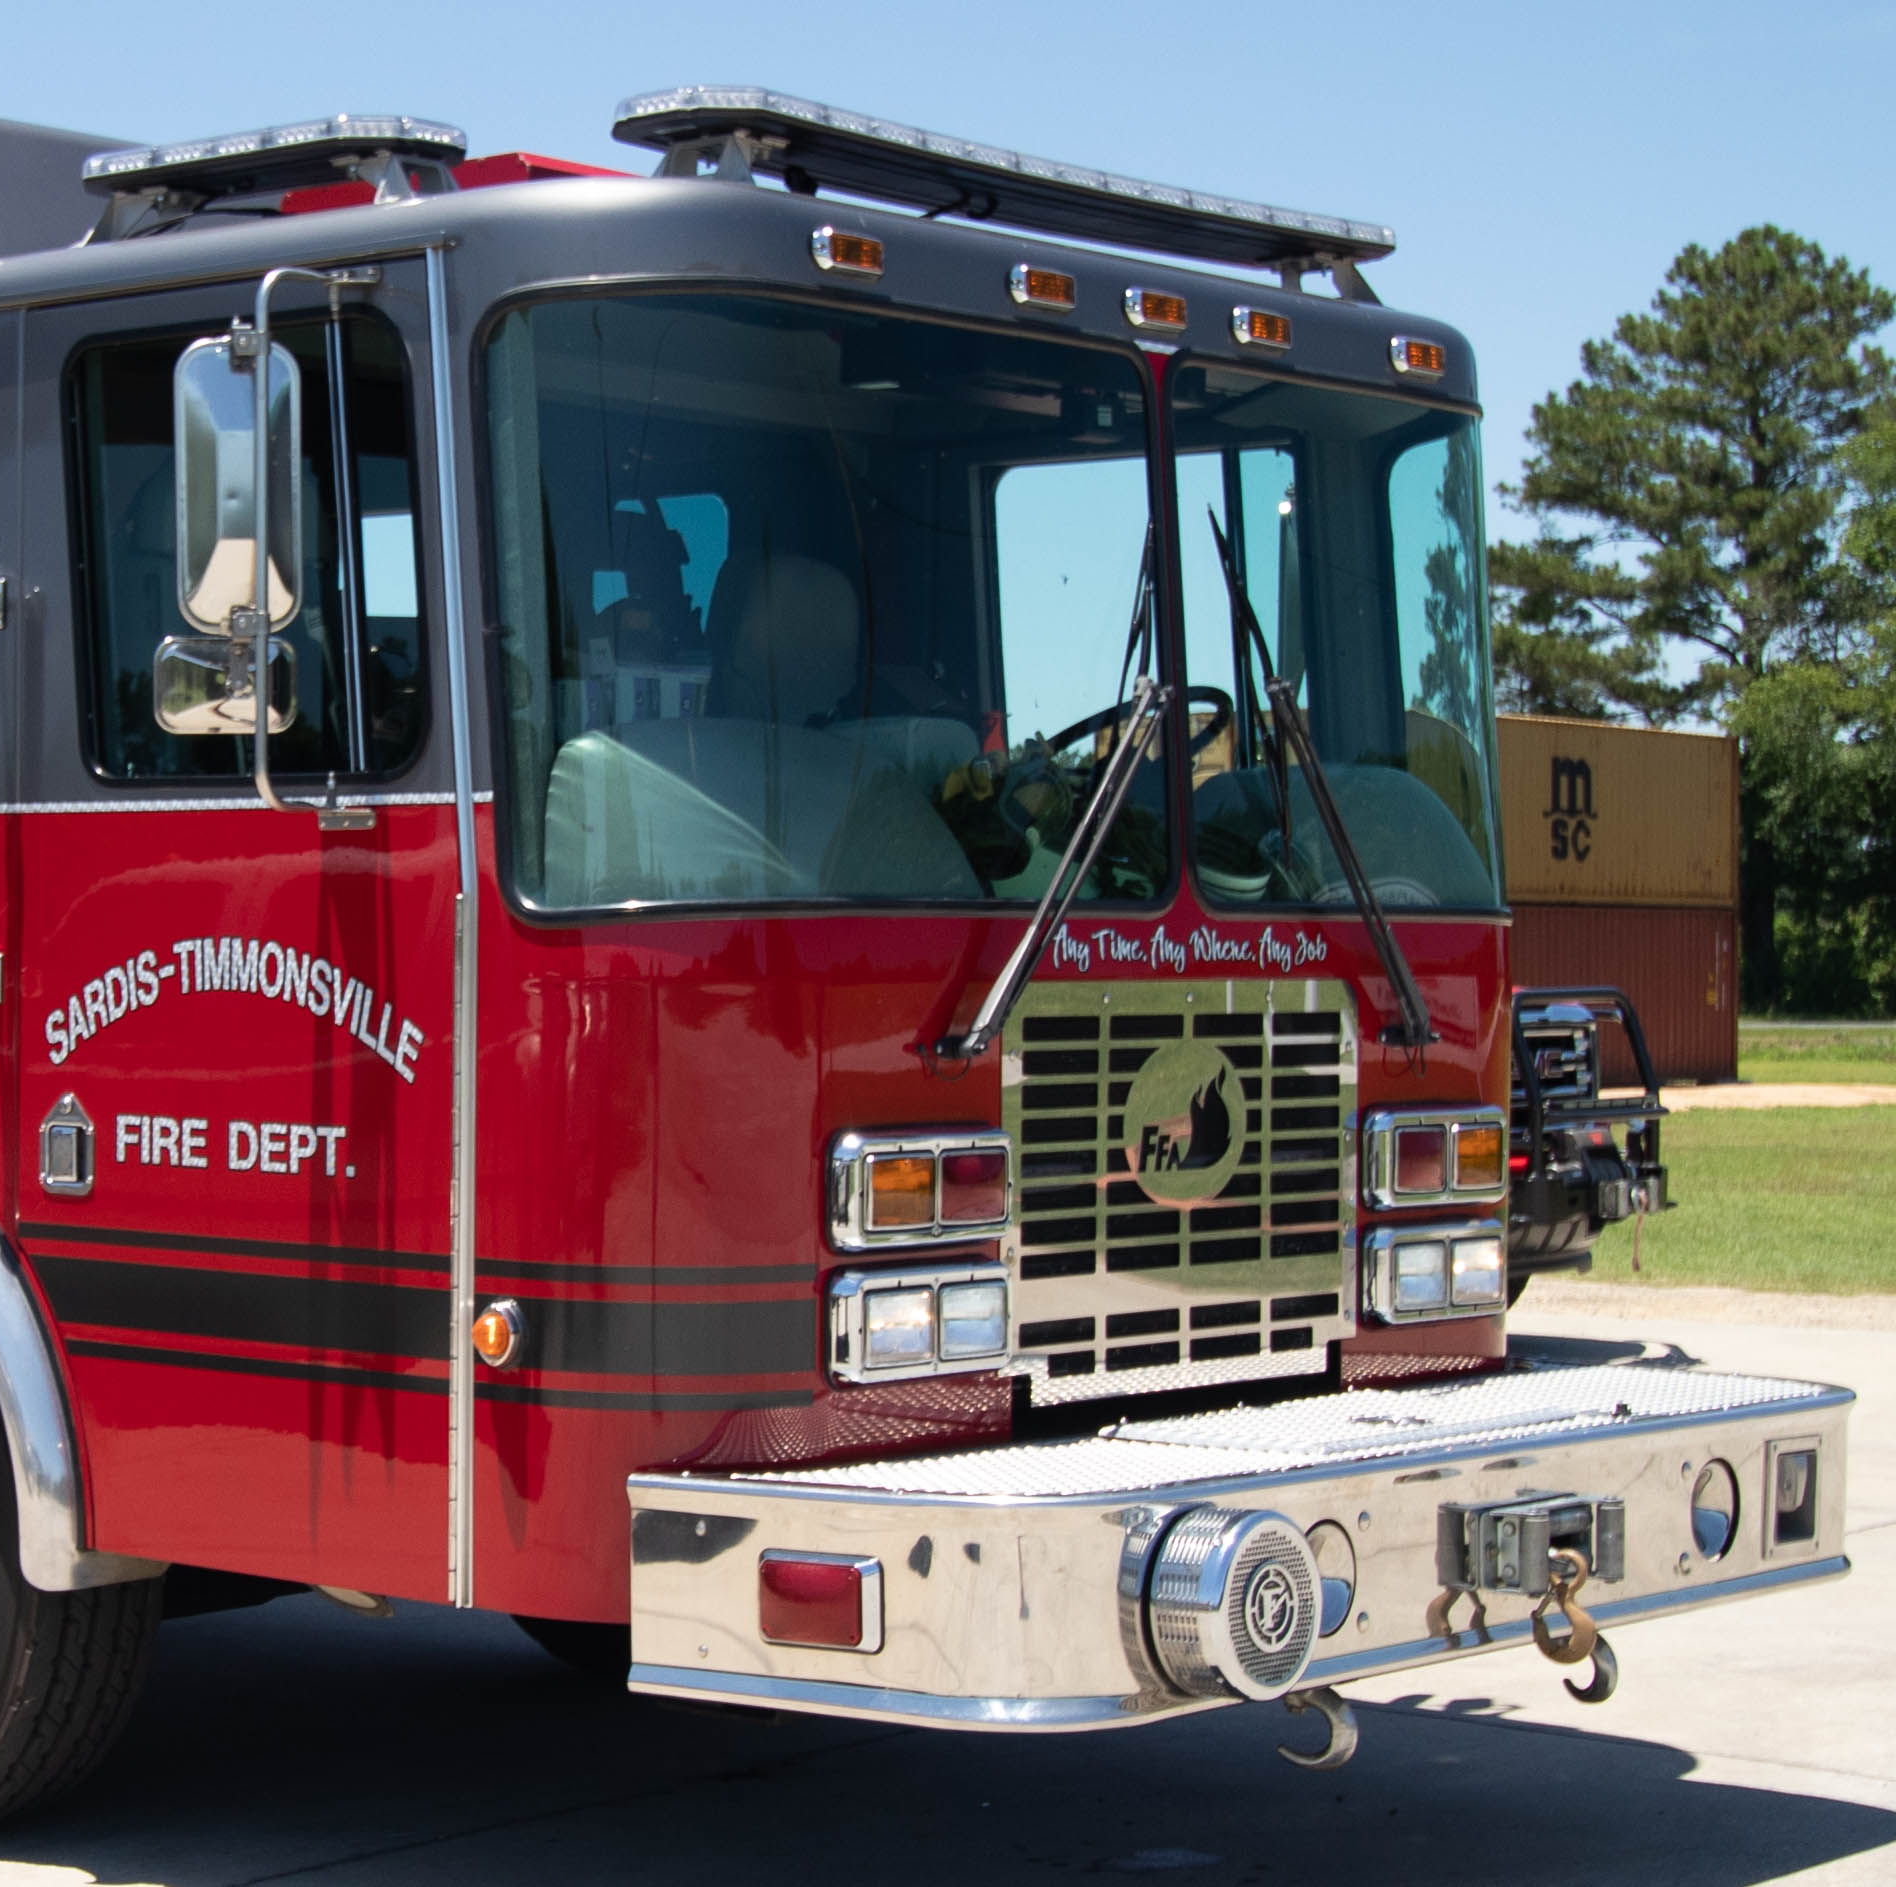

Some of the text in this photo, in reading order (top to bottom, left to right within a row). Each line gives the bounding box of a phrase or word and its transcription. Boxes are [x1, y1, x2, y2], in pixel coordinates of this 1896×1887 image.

[1053, 923, 1089, 973] Any
[1150, 924, 1187, 973] Any
[1258, 925, 1292, 973] Any
[1294, 930, 1329, 966] Job
[44, 935, 425, 1085] SARDIS-TIMMONSVILLE
[114, 1113, 358, 1179] FIRE DEPT.
[1138, 1125, 1183, 1173] FFA
